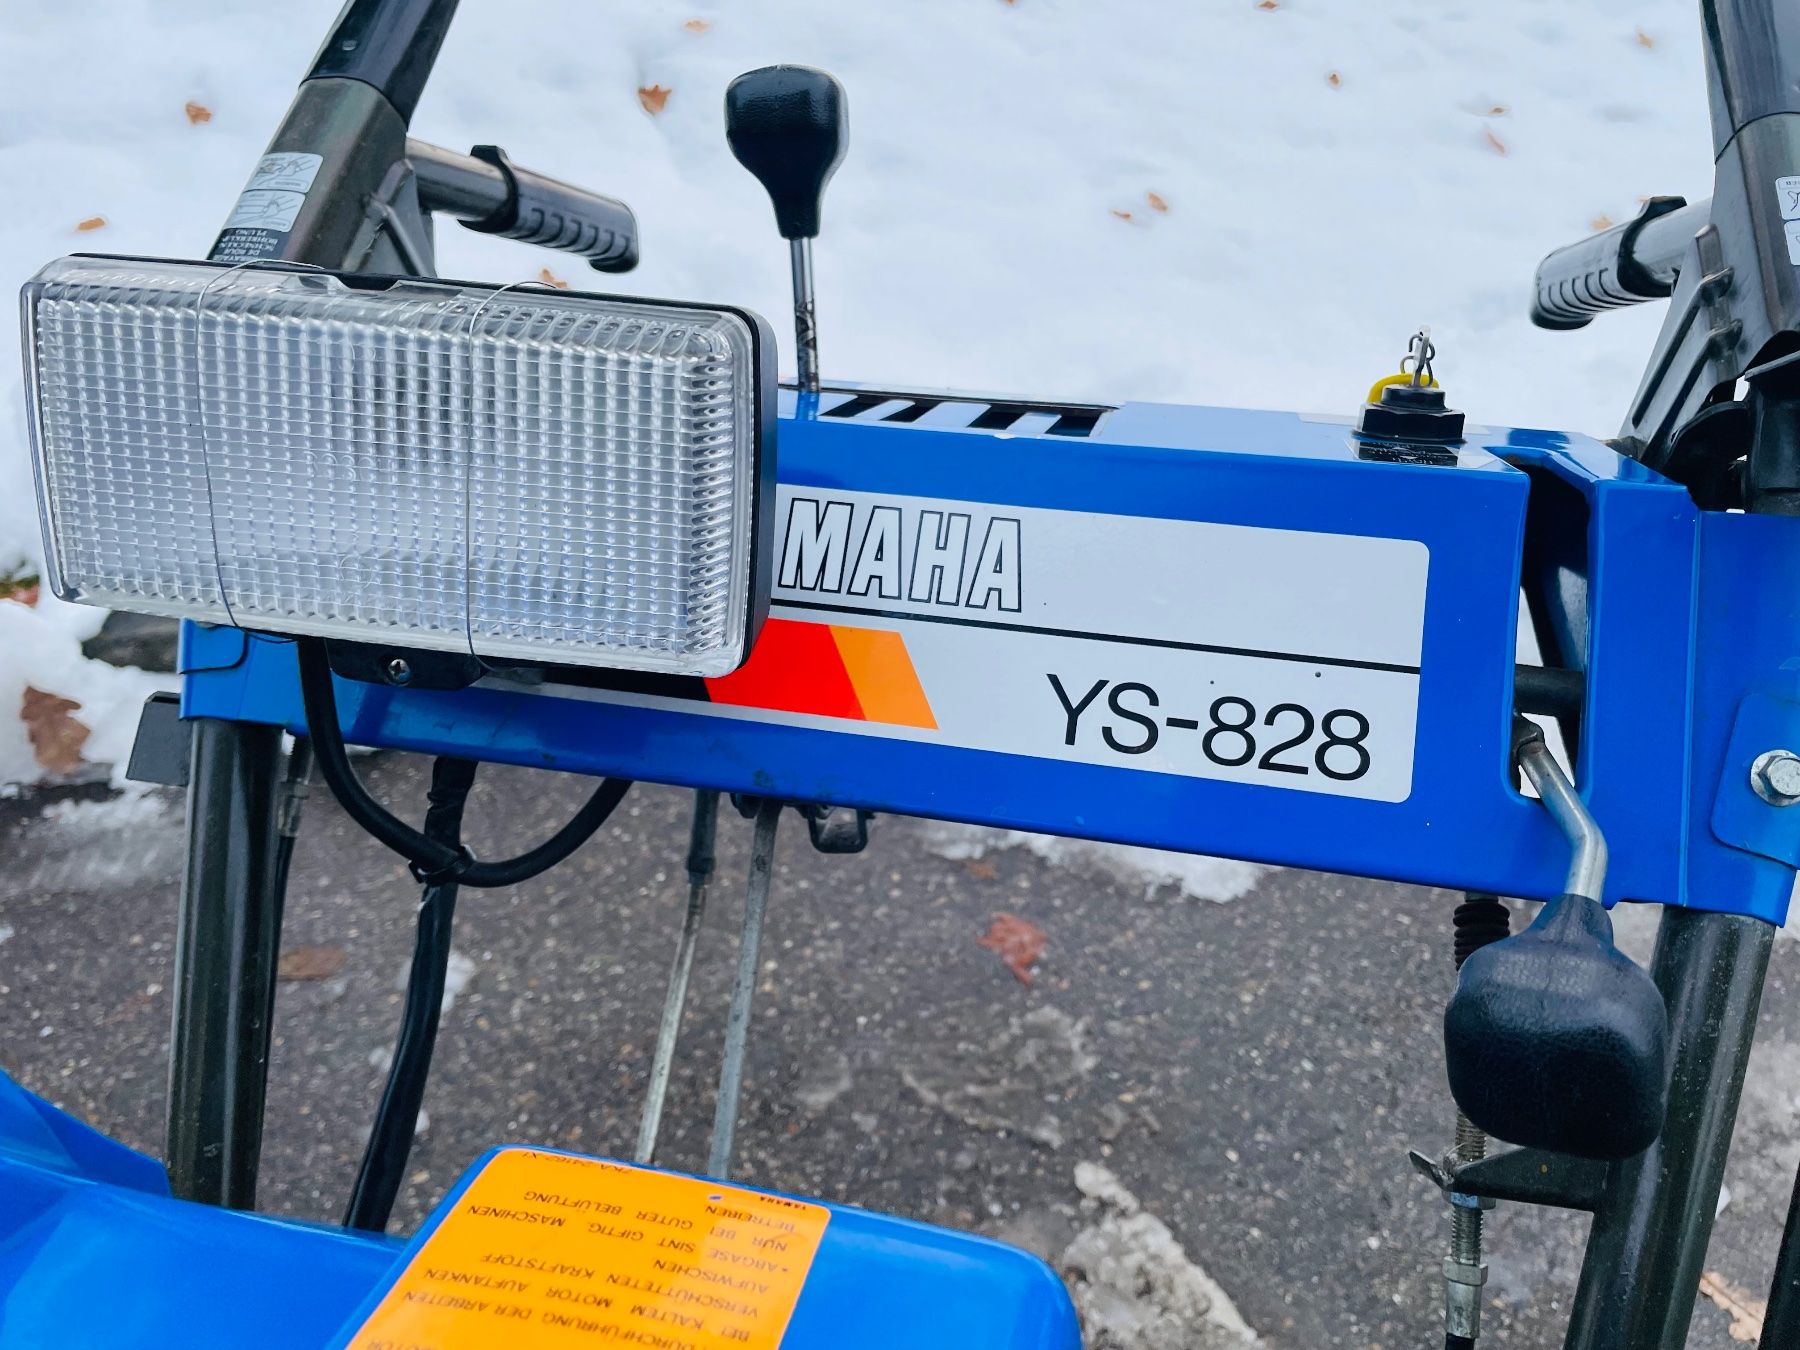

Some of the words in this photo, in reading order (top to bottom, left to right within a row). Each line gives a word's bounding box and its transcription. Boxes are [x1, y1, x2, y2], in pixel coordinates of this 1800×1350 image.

[777, 497, 1022, 613] MAHA
[1046, 673, 1371, 782] YS-828
[525, 1191, 622, 1214] BELÜFTUNG
[468, 1205, 565, 1226] MASCHINEN
[637, 1211, 693, 1229] GUTER
[711, 1227, 736, 1239] BEI
[753, 1236, 787, 1250] NUR
[659, 1238, 696, 1251] SINT
[481, 1254, 595, 1278] KRAFTSTOFF
[712, 1249, 778, 1271] ABGASE
[425, 1269, 530, 1291] AUFTANKEN
[405, 1292, 490, 1310] ARBEITEN
[547, 1287, 613, 1307] MOTOR
[608, 1274, 758, 1316] VERSCHÜTTETEN
[496, 1305, 532, 1318] DER
[632, 1304, 704, 1328] KALTEM
[722, 1328, 749, 1341] BEI
